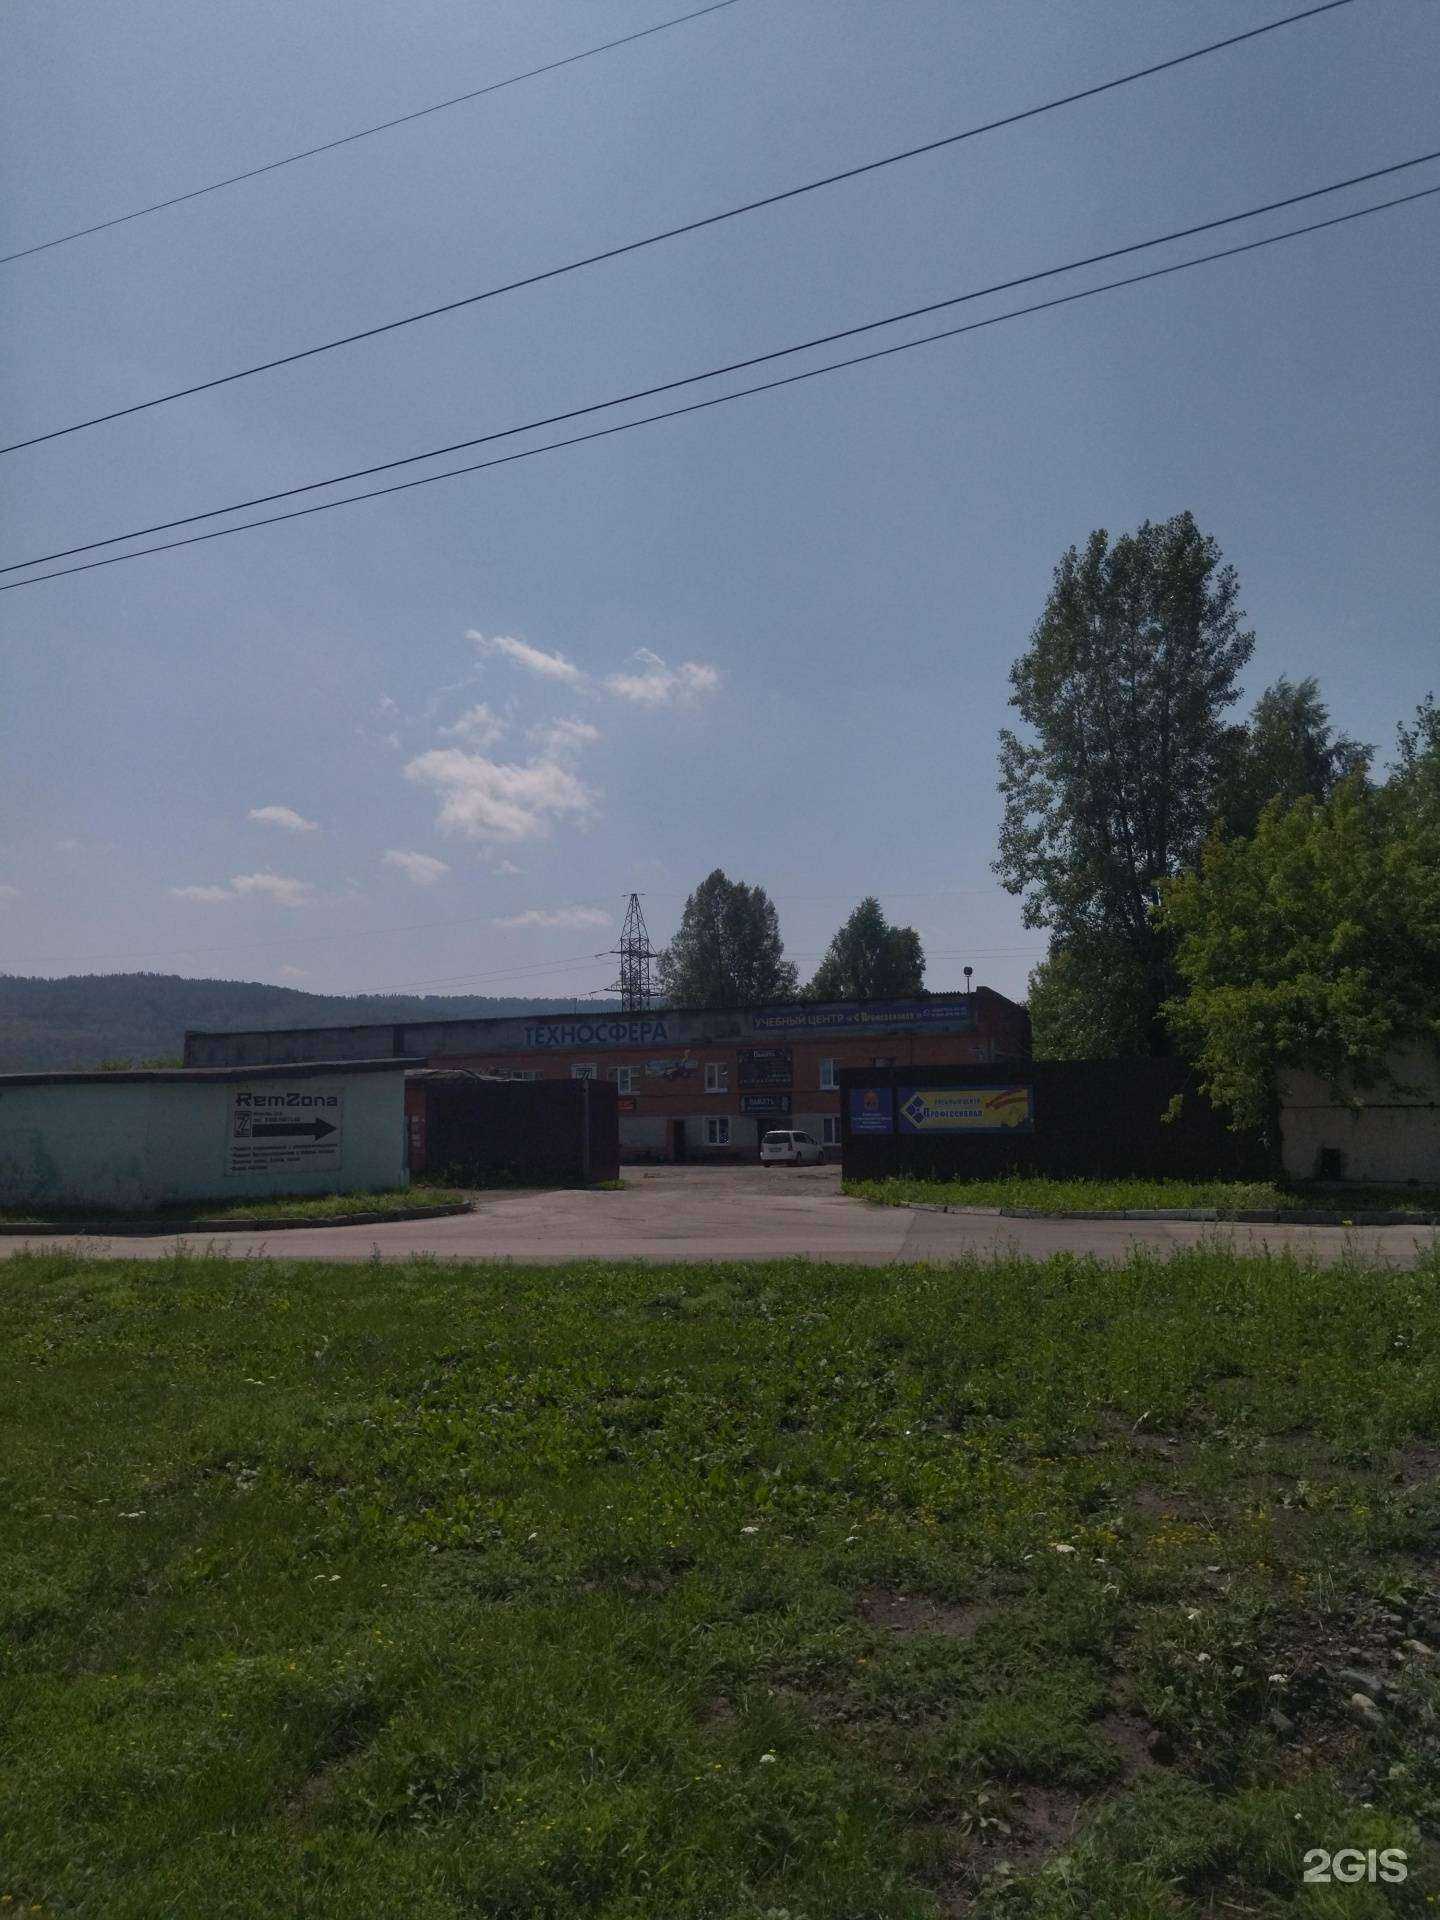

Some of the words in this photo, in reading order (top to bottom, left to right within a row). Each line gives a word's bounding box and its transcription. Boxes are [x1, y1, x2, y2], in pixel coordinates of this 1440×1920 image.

[754, 1015, 805, 1028] УЧЕБНЫЙ
[808, 1014, 844, 1026] ЦЕНТР
[524, 1022, 668, 1048] ТЕХНОСФЕРА
[236, 1093, 338, 1106] RemZona
